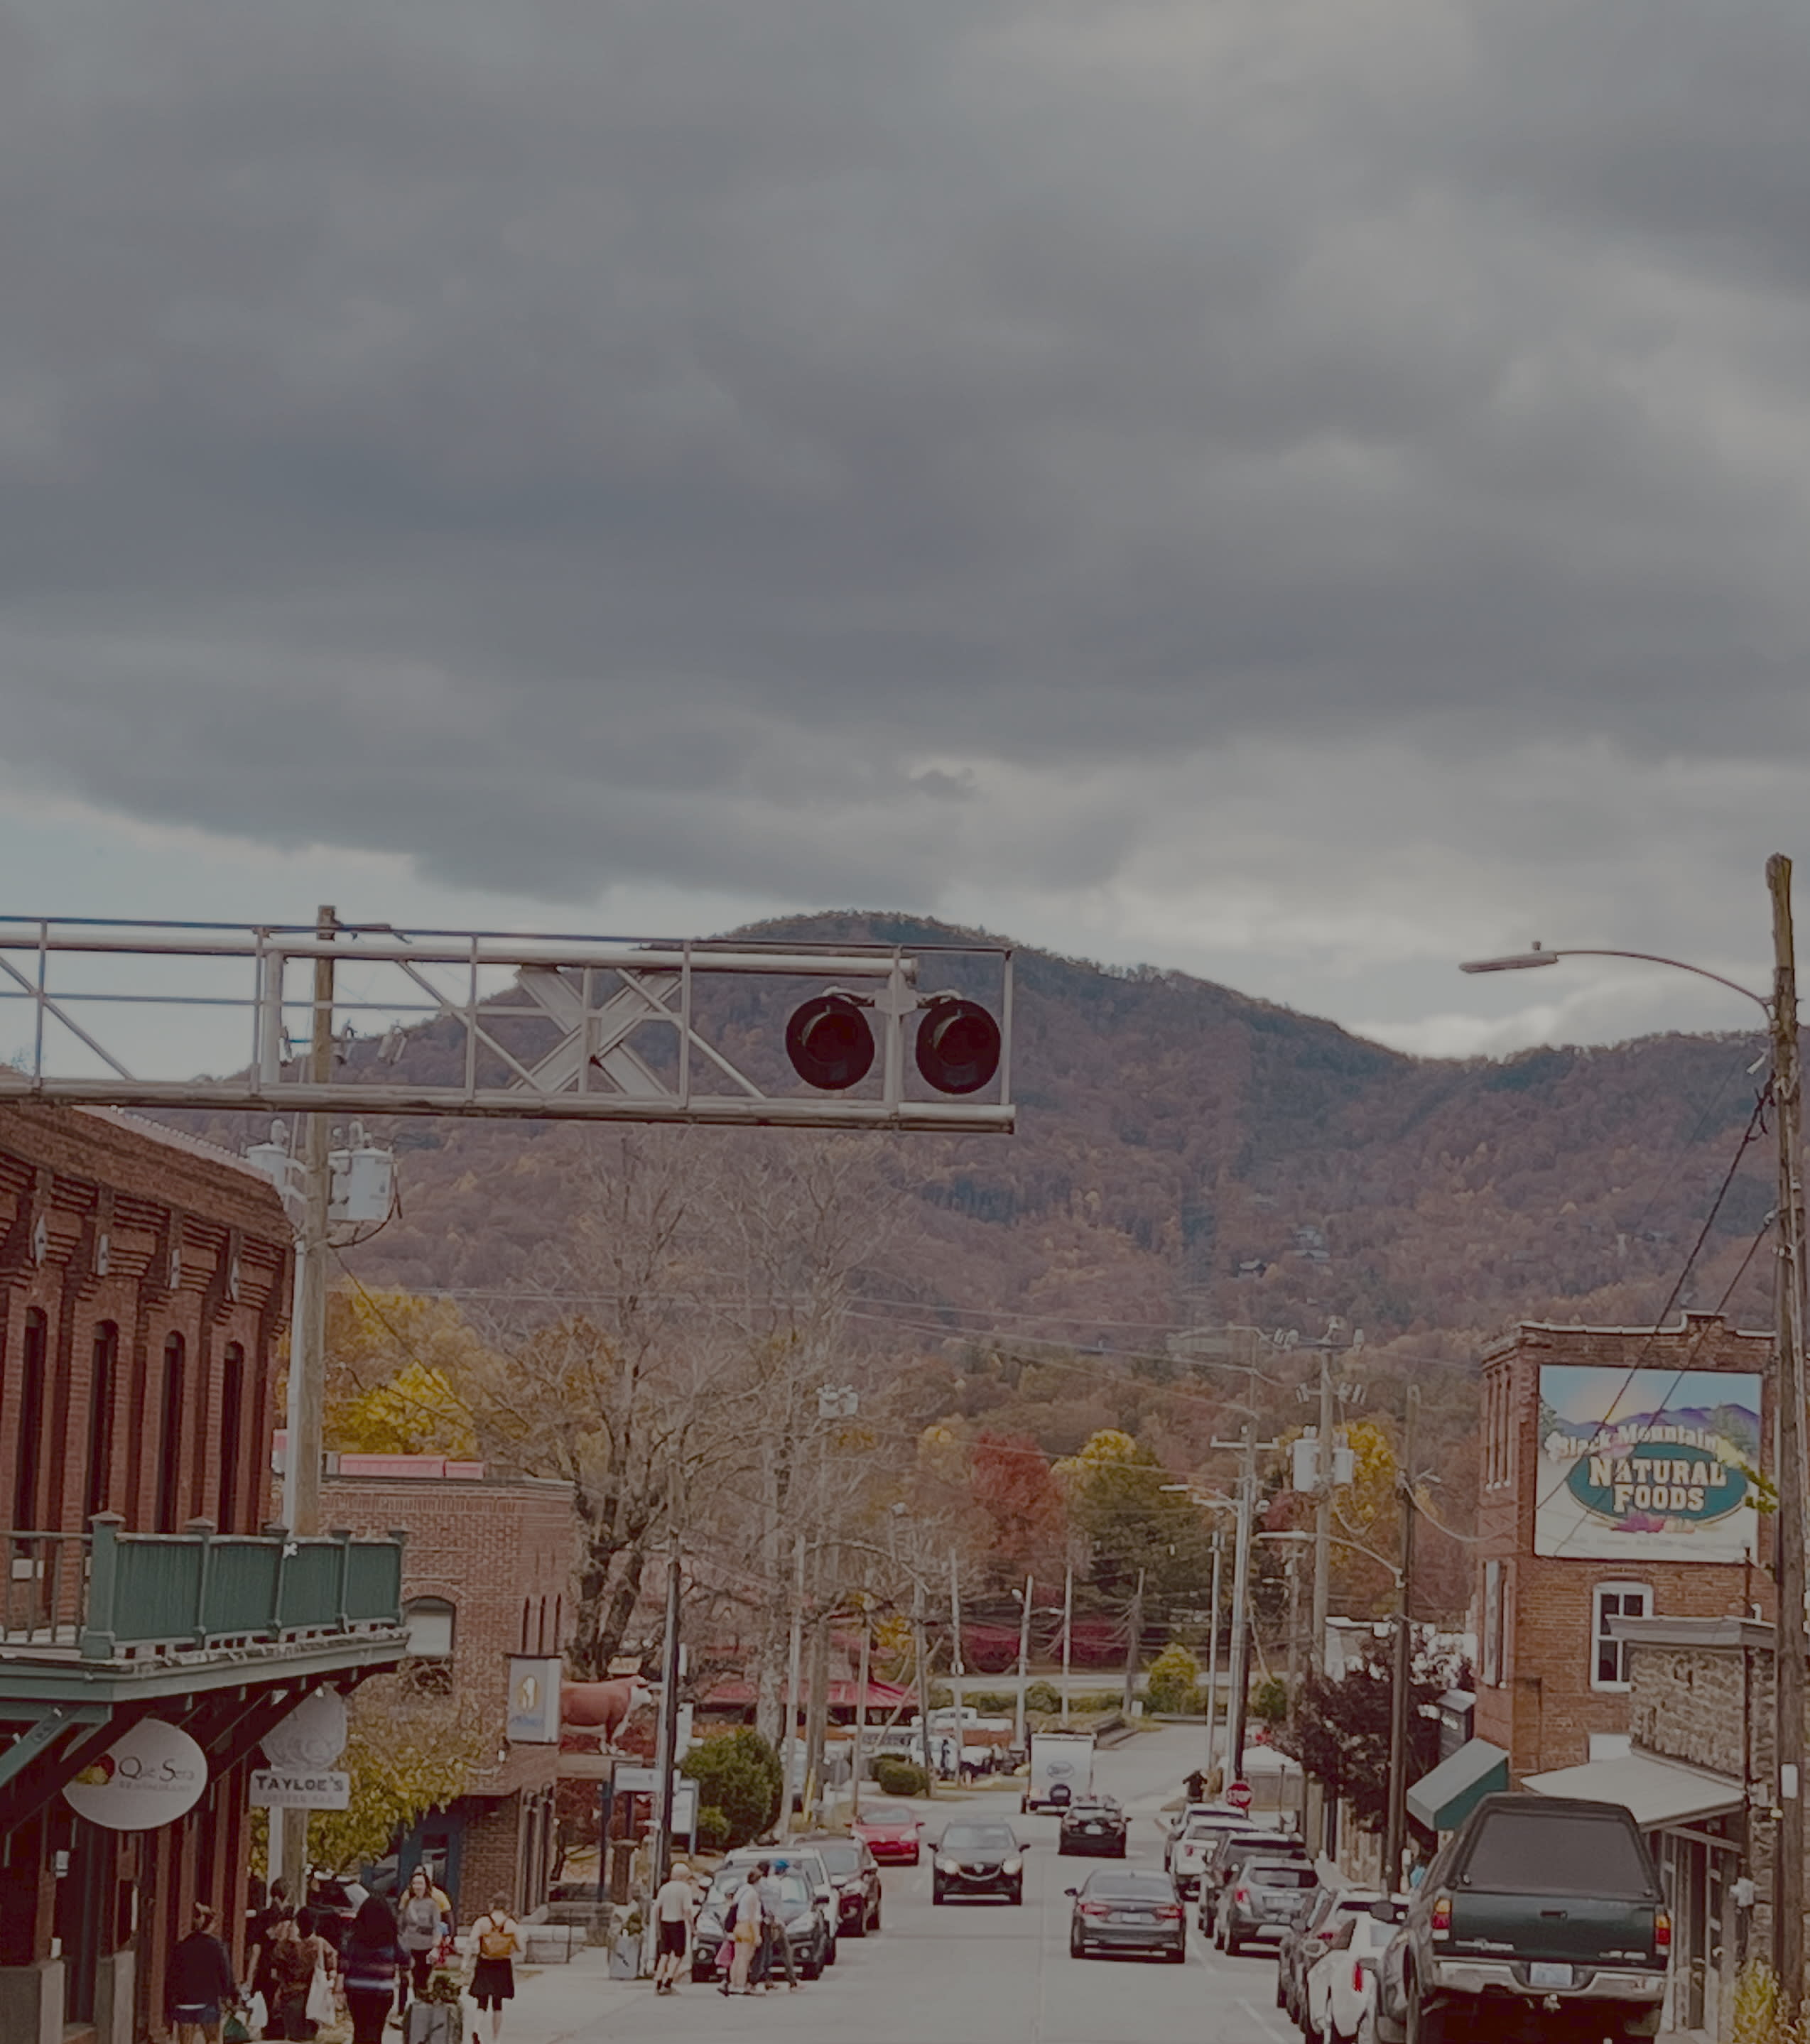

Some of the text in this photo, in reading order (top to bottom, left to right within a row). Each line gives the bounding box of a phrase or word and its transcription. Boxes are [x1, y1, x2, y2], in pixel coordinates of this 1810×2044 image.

[1559, 1423, 1717, 1456] Black Mountain
[1589, 1457, 1727, 1486] NATURAL
[1613, 1486, 1704, 1512] FOODS
